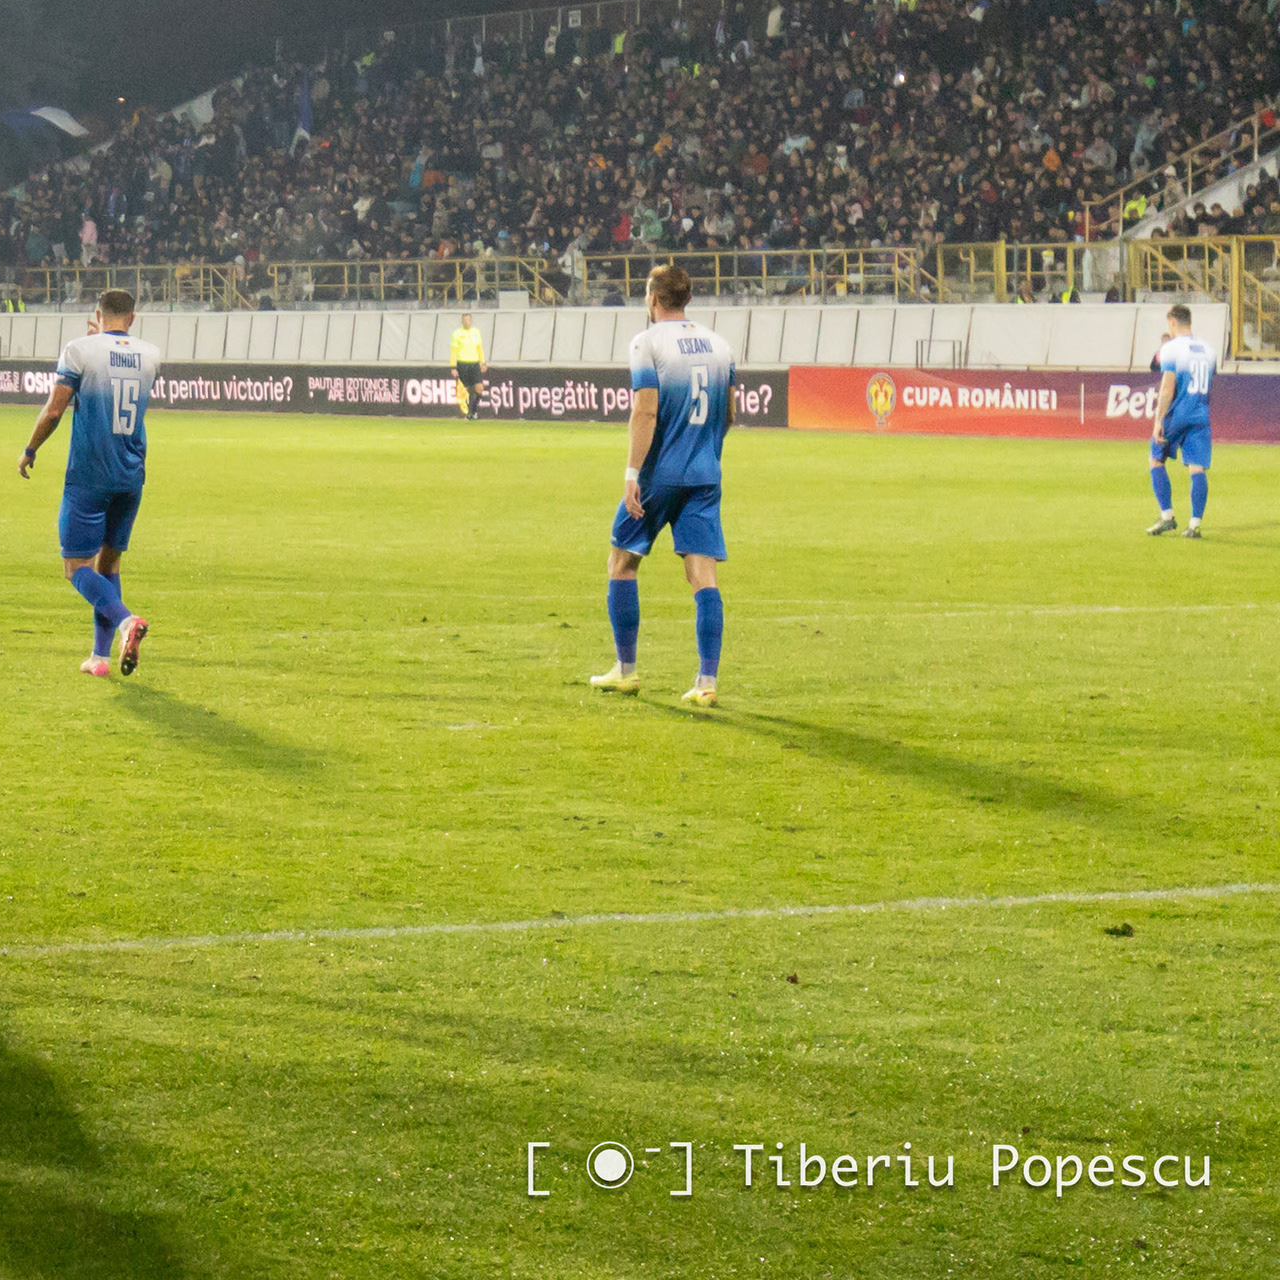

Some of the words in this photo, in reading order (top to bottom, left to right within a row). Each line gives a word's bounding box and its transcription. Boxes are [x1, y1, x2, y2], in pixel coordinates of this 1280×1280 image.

[24, 371, 58, 394] OSH
[169, 376, 220, 403] pentru
[223, 375, 293, 402] victorie?
[1187, 359, 1209, 395] 30
[328, 389, 345, 402] APE
[361, 390, 400, 403] VITAMINE
[406, 378, 457, 405] OSHE
[518, 380, 598, 415] pregătit
[902, 385, 953, 407] CUPA
[957, 382, 1058, 410] ROMÂNIEI
[1106, 384, 1159, 419] Bet
[110, 377, 141, 436] 15
